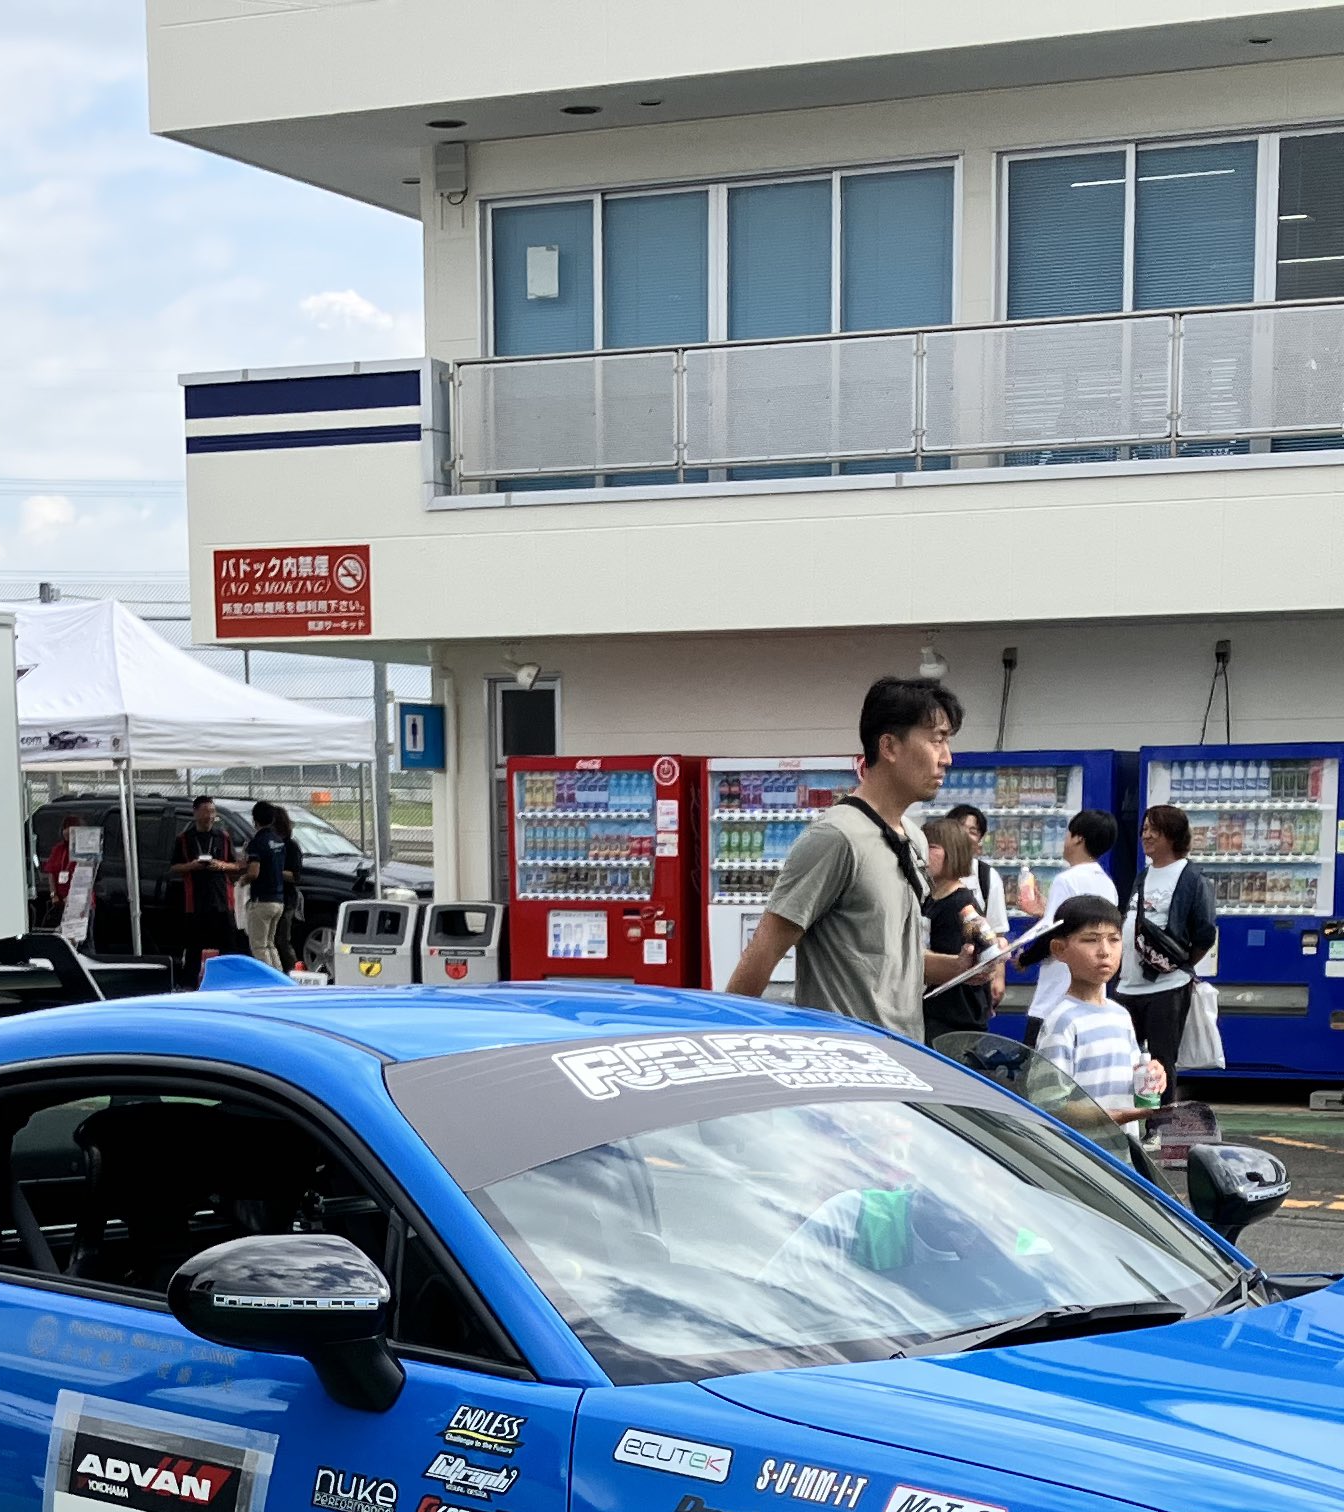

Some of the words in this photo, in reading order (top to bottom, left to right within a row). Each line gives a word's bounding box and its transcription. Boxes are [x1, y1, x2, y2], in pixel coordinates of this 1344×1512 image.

[221, 555, 329, 579] パドック内禁煙
[450, 1405, 525, 1440] ENDLESS
[77, 1453, 211, 1501] ADVAN
[88, 1480, 129, 1498] YOKOHAMA
[316, 1469, 397, 1507] nuke
